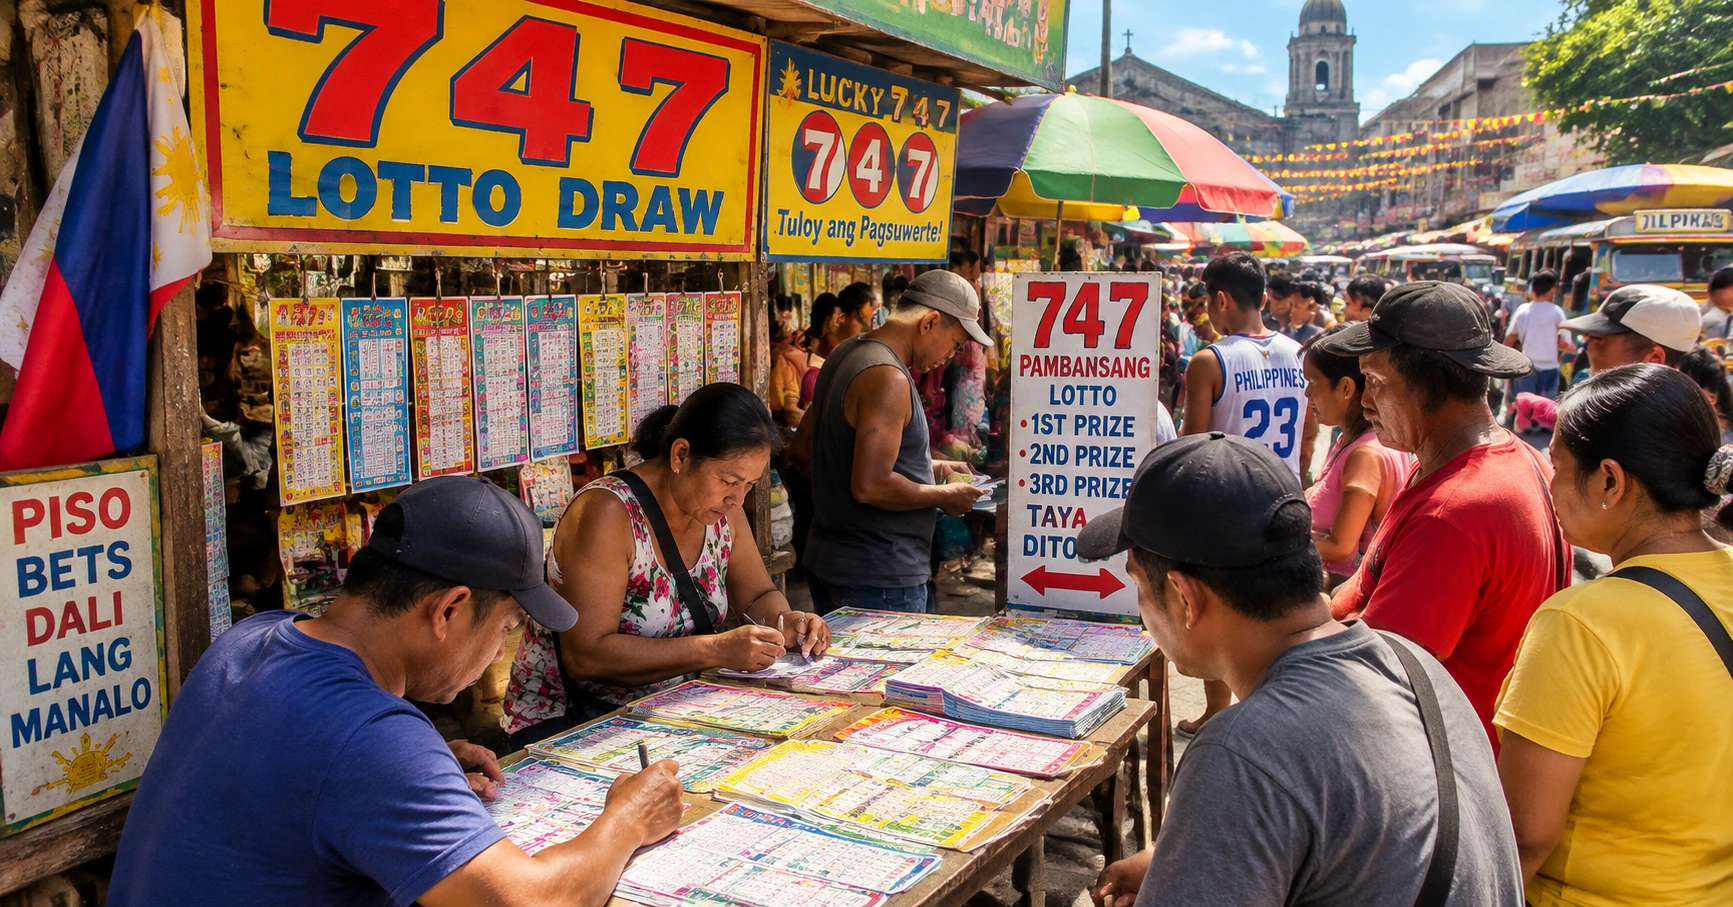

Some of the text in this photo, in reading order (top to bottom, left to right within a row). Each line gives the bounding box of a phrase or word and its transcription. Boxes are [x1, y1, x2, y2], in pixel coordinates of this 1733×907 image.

[265, 0, 731, 178] 747
[807, 69, 885, 116] LUCKY
[267, 151, 724, 235] LOTTO DRAW
[827, 218, 856, 247] ang
[860, 215, 943, 248] Pagsuwerte!
[1028, 281, 1149, 349] 747
[1019, 354, 1150, 379] PAMBANSANG
[1234, 367, 1305, 393] PHILIPPINES
[1049, 384, 1117, 407] LOTTO
[1032, 412, 1135, 438] 1ST PRIZE
[1243, 396, 1299, 459] 23
[1030, 443, 1136, 469] 2ND PRIZE
[1029, 473, 1133, 499] 3RD PRIZE
[12, 487, 132, 545] PISO
[1027, 504, 1087, 529] TAYA
[16, 540, 132, 598] BETS
[1023, 534, 1077, 560] DITO
[25, 591, 123, 647] DALI
[27, 637, 132, 696] LANG
[10, 677, 152, 749] MANALO
